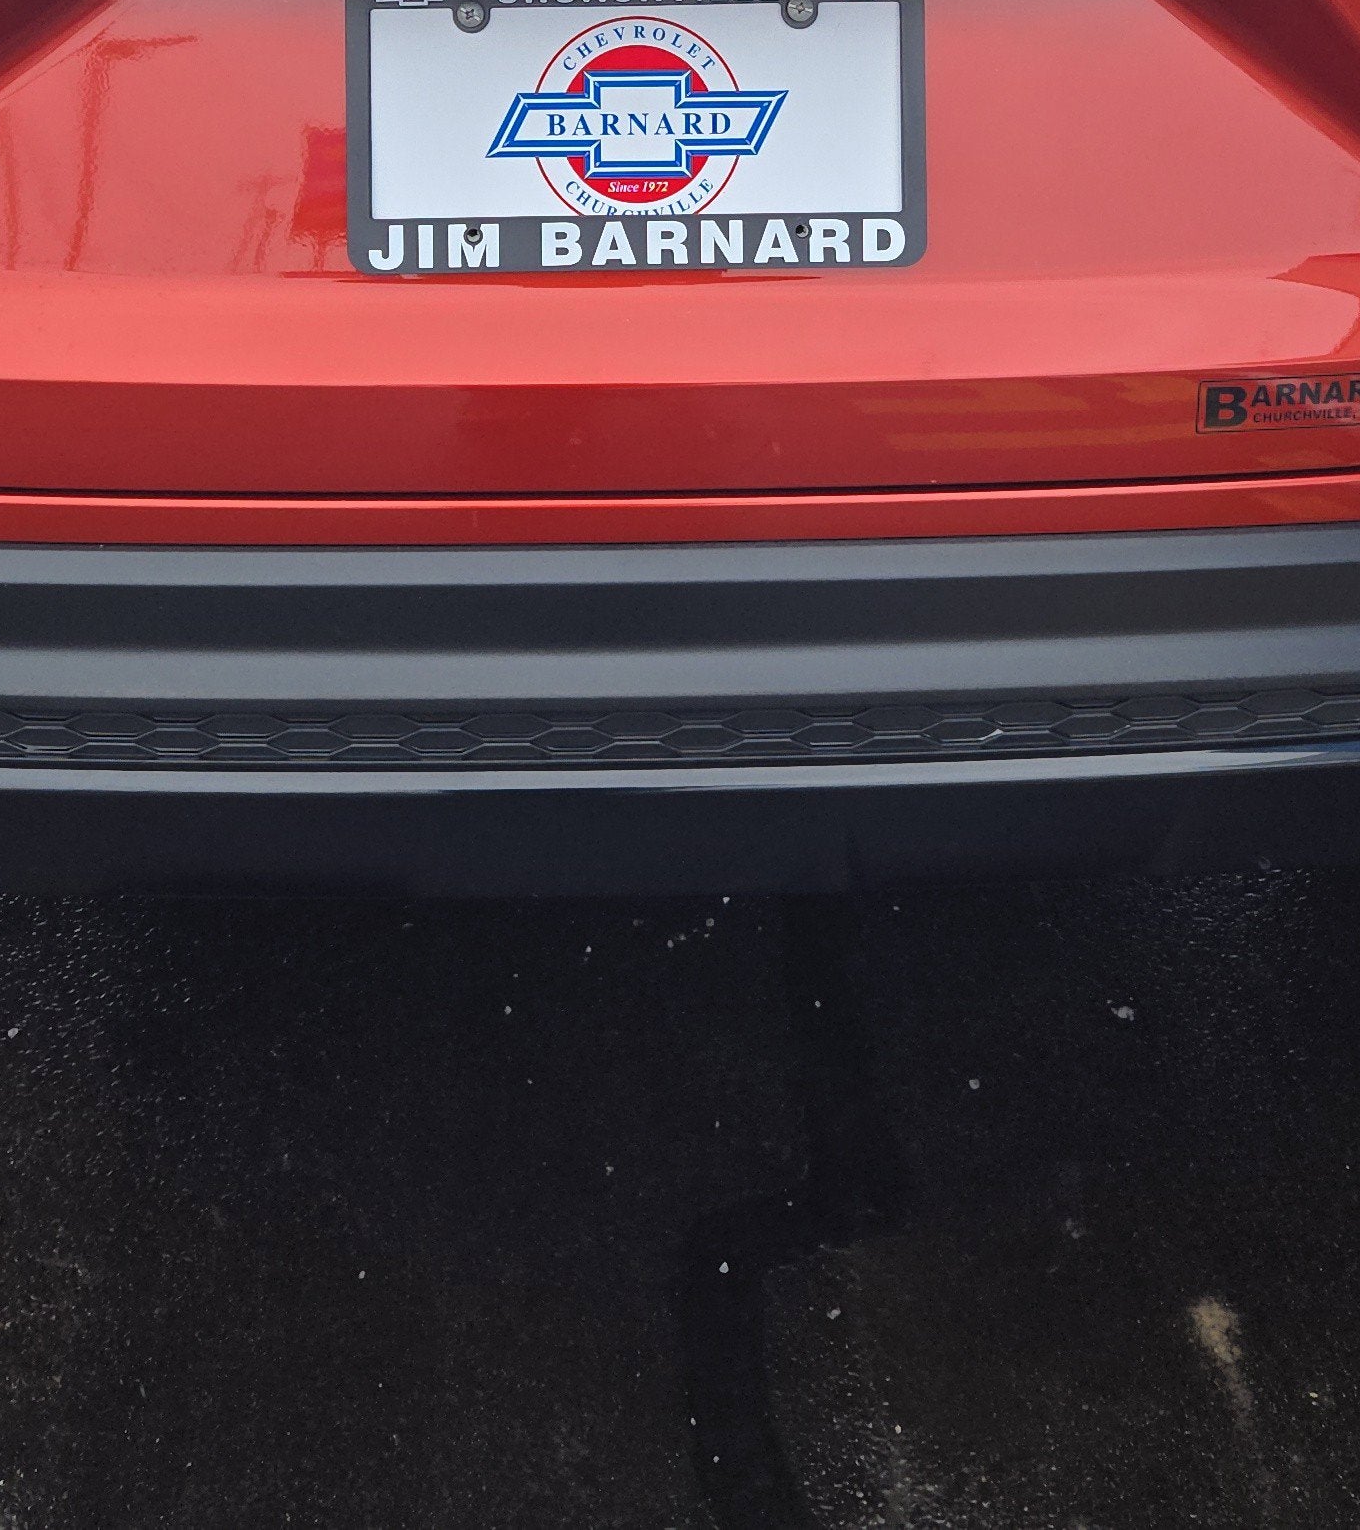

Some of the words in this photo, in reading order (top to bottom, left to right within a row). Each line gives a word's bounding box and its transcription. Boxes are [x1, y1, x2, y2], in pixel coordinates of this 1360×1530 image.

[563, 25, 715, 71] CHEVROLET
[546, 112, 731, 136] BARNARD
[607, 181, 640, 193] Since
[642, 181, 669, 193] 1972
[368, 224, 501, 270] JIM
[541, 218, 907, 267] BARNARD
